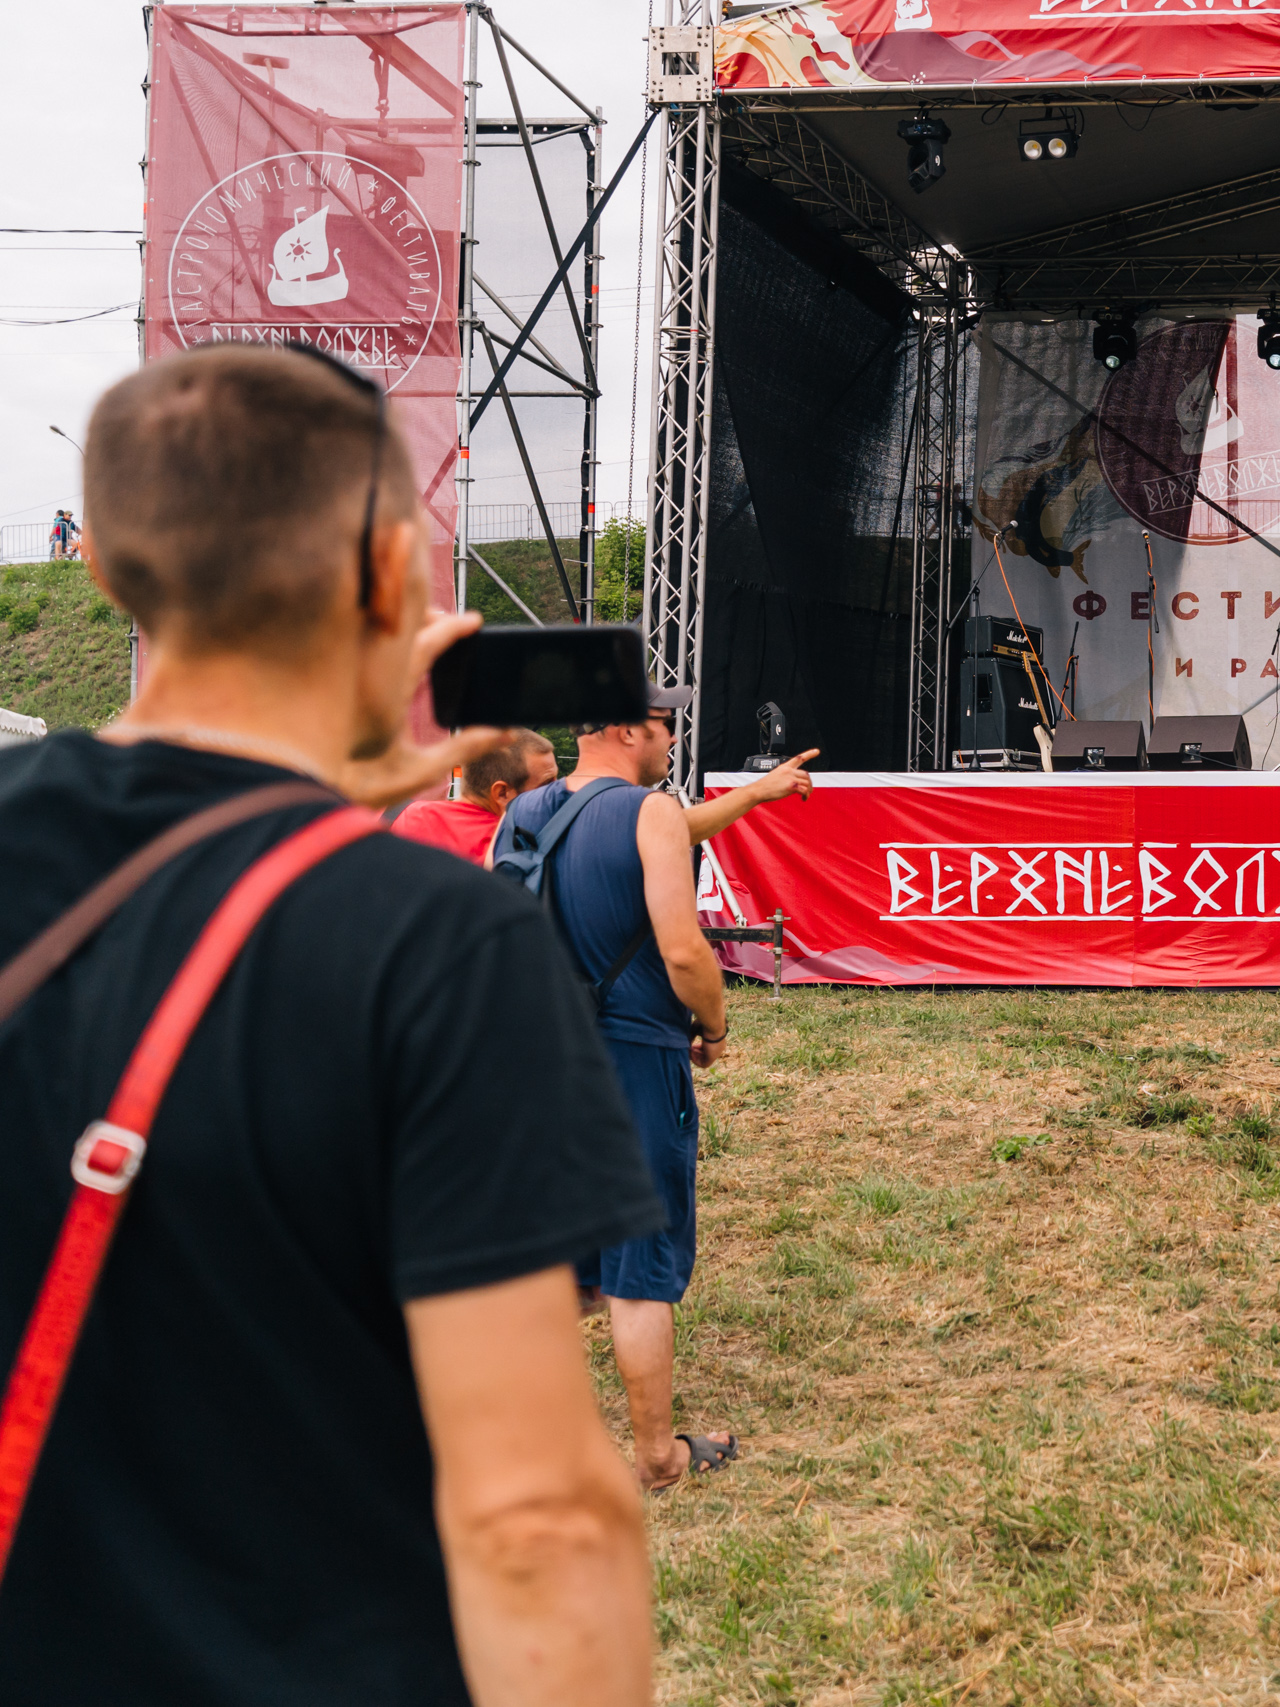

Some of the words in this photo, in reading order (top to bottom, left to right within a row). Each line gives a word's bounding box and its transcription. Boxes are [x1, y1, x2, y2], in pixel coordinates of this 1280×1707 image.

[177, 161, 352, 329] ГАСТРОНОМИЧЕСКИЙ
[380, 196, 431, 326] ФЕСТИВАЛЬ
[1175, 657, 1193, 678] И
